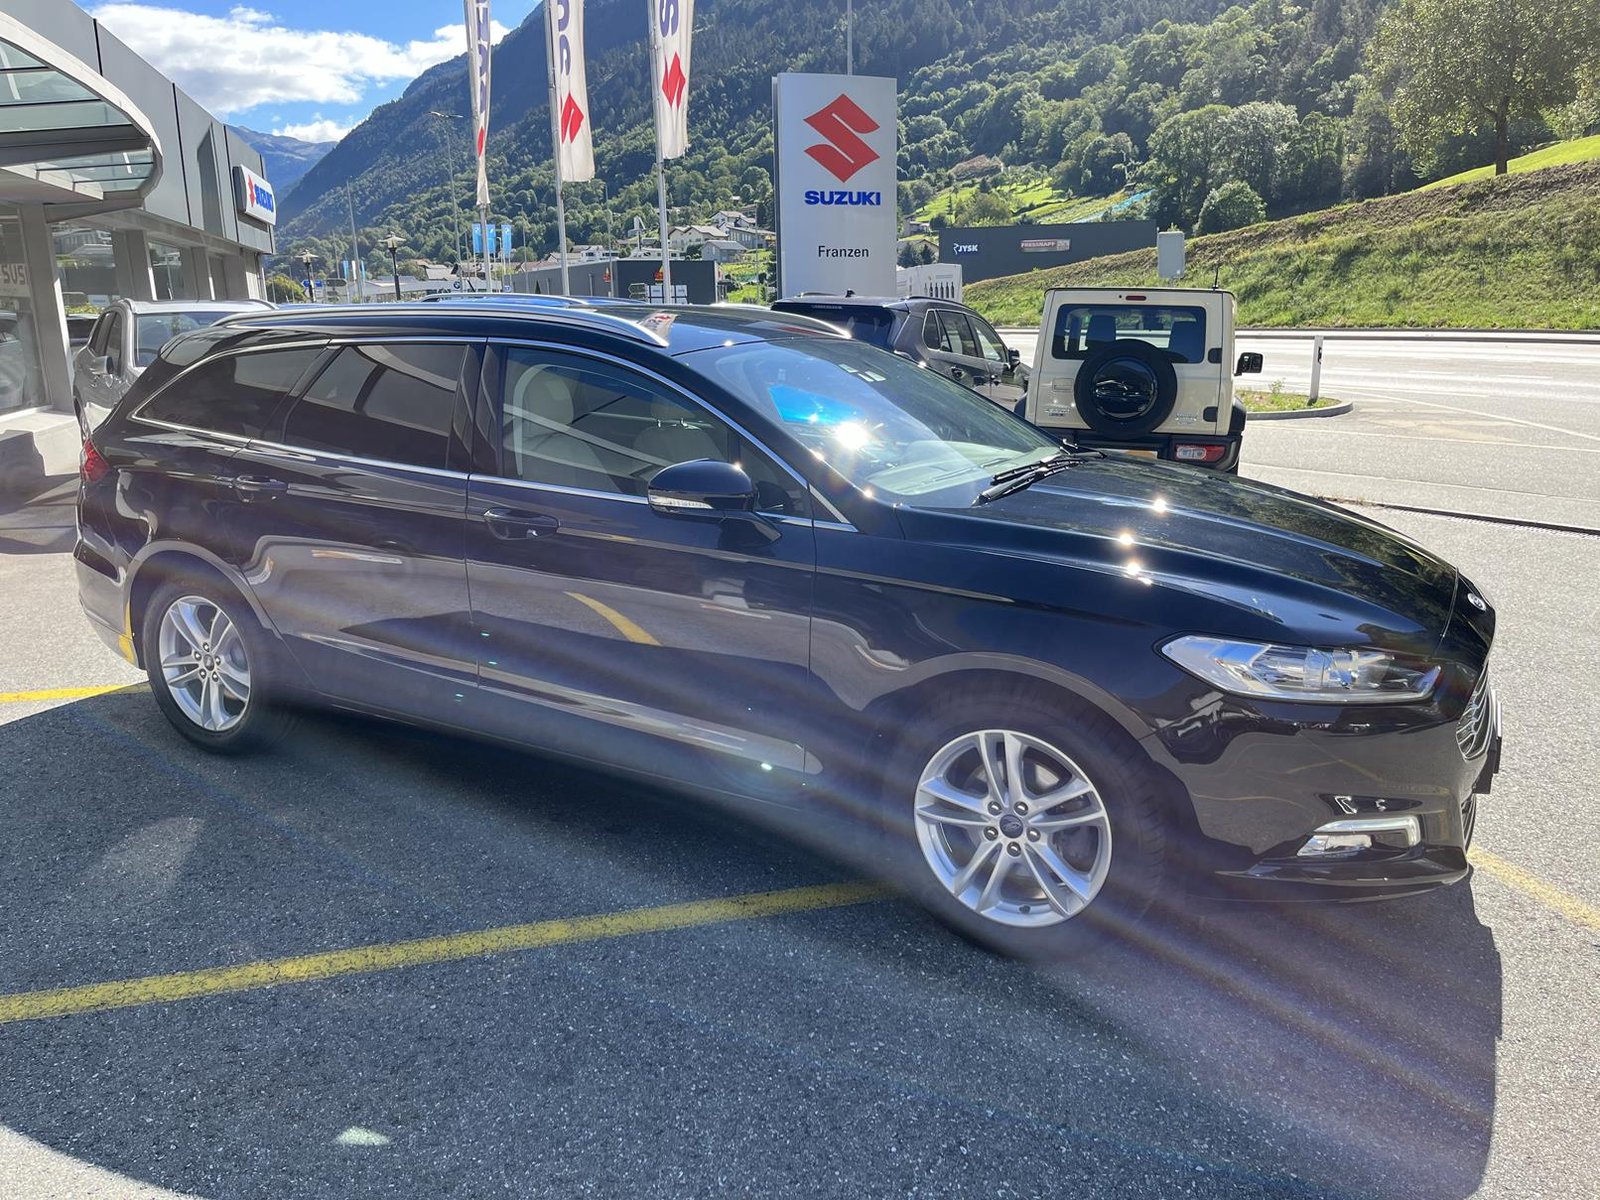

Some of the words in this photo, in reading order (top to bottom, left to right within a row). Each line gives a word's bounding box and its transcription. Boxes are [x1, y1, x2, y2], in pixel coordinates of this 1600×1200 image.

[804, 190, 881, 206] SUZUKI
[818, 245, 869, 258] Franzen
[958, 244, 978, 252] JYSK
